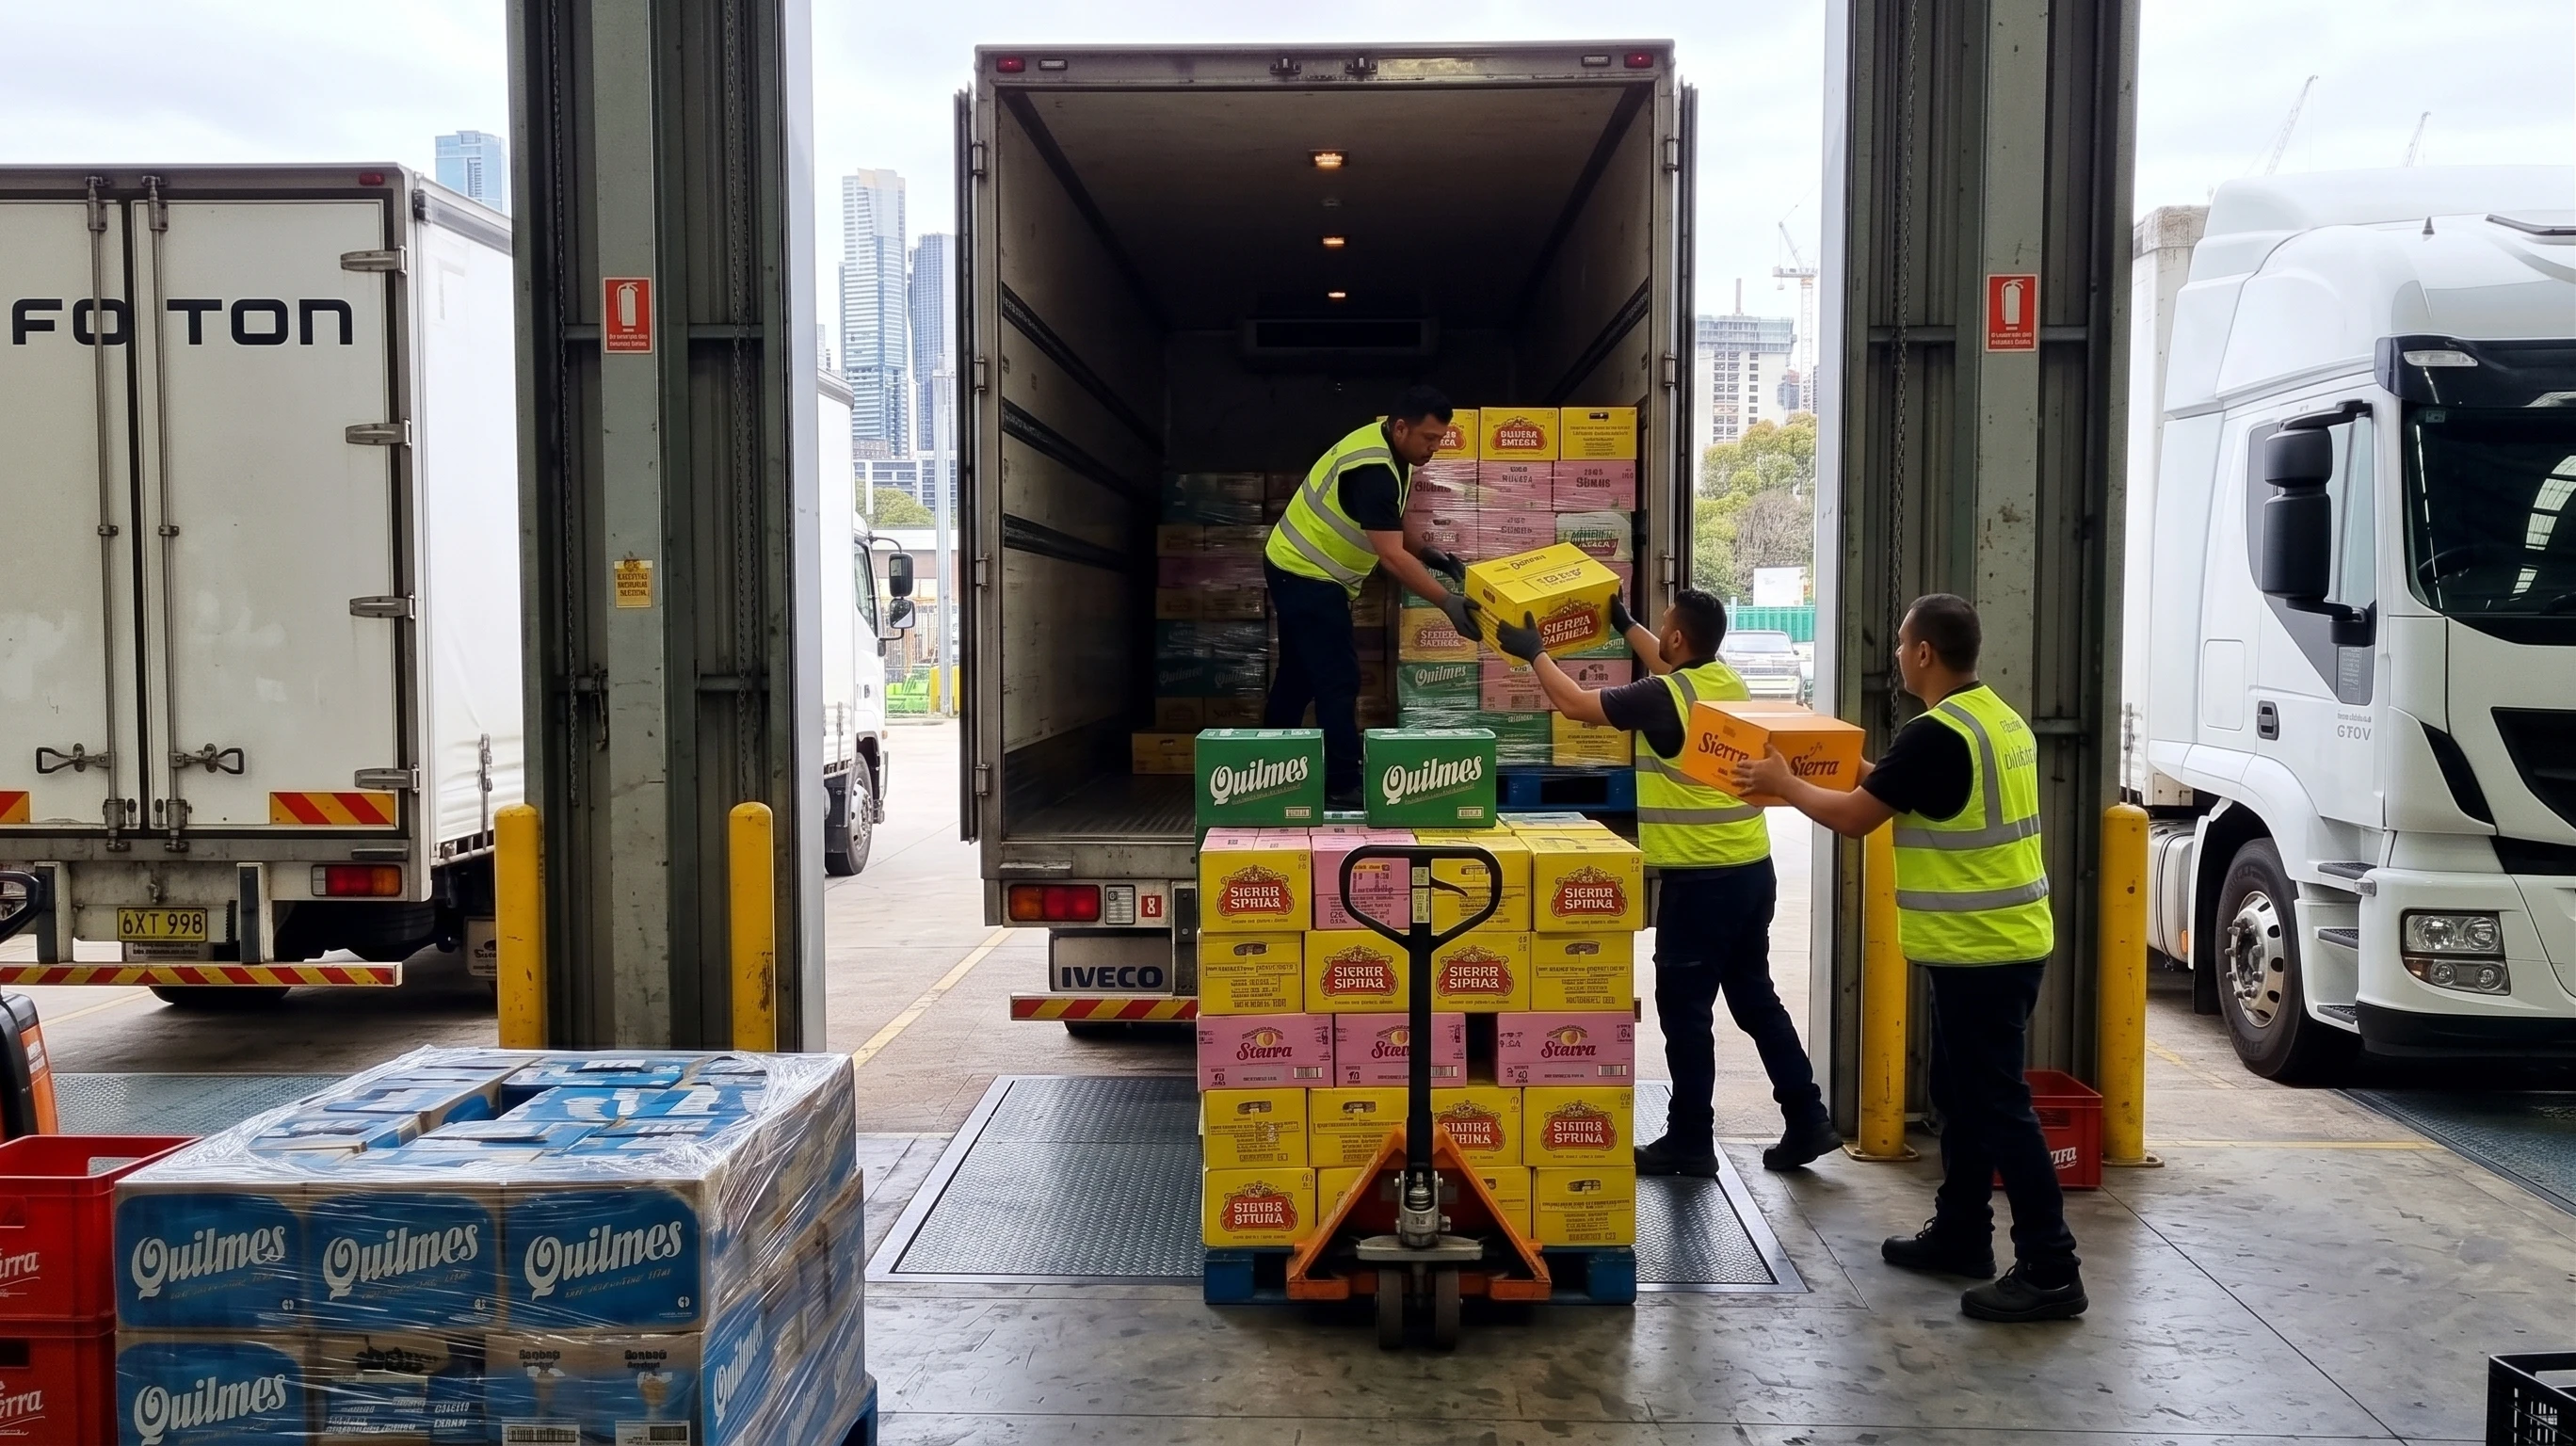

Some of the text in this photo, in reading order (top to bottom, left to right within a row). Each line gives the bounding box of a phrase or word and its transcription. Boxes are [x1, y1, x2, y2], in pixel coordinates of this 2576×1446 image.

[1210, 755, 1309, 806] Quilmes
[1382, 755, 1483, 806] Quilmes
[1791, 754, 1840, 777] Sierra
[122, 913, 202, 934] 6XT 998
[1061, 966, 1164, 988] IVECO
[131, 1225, 286, 1301] Quilmes
[323, 1224, 479, 1301] Quilmes
[524, 1220, 683, 1301] Quilmes
[134, 1374, 287, 1446] Quilmes
